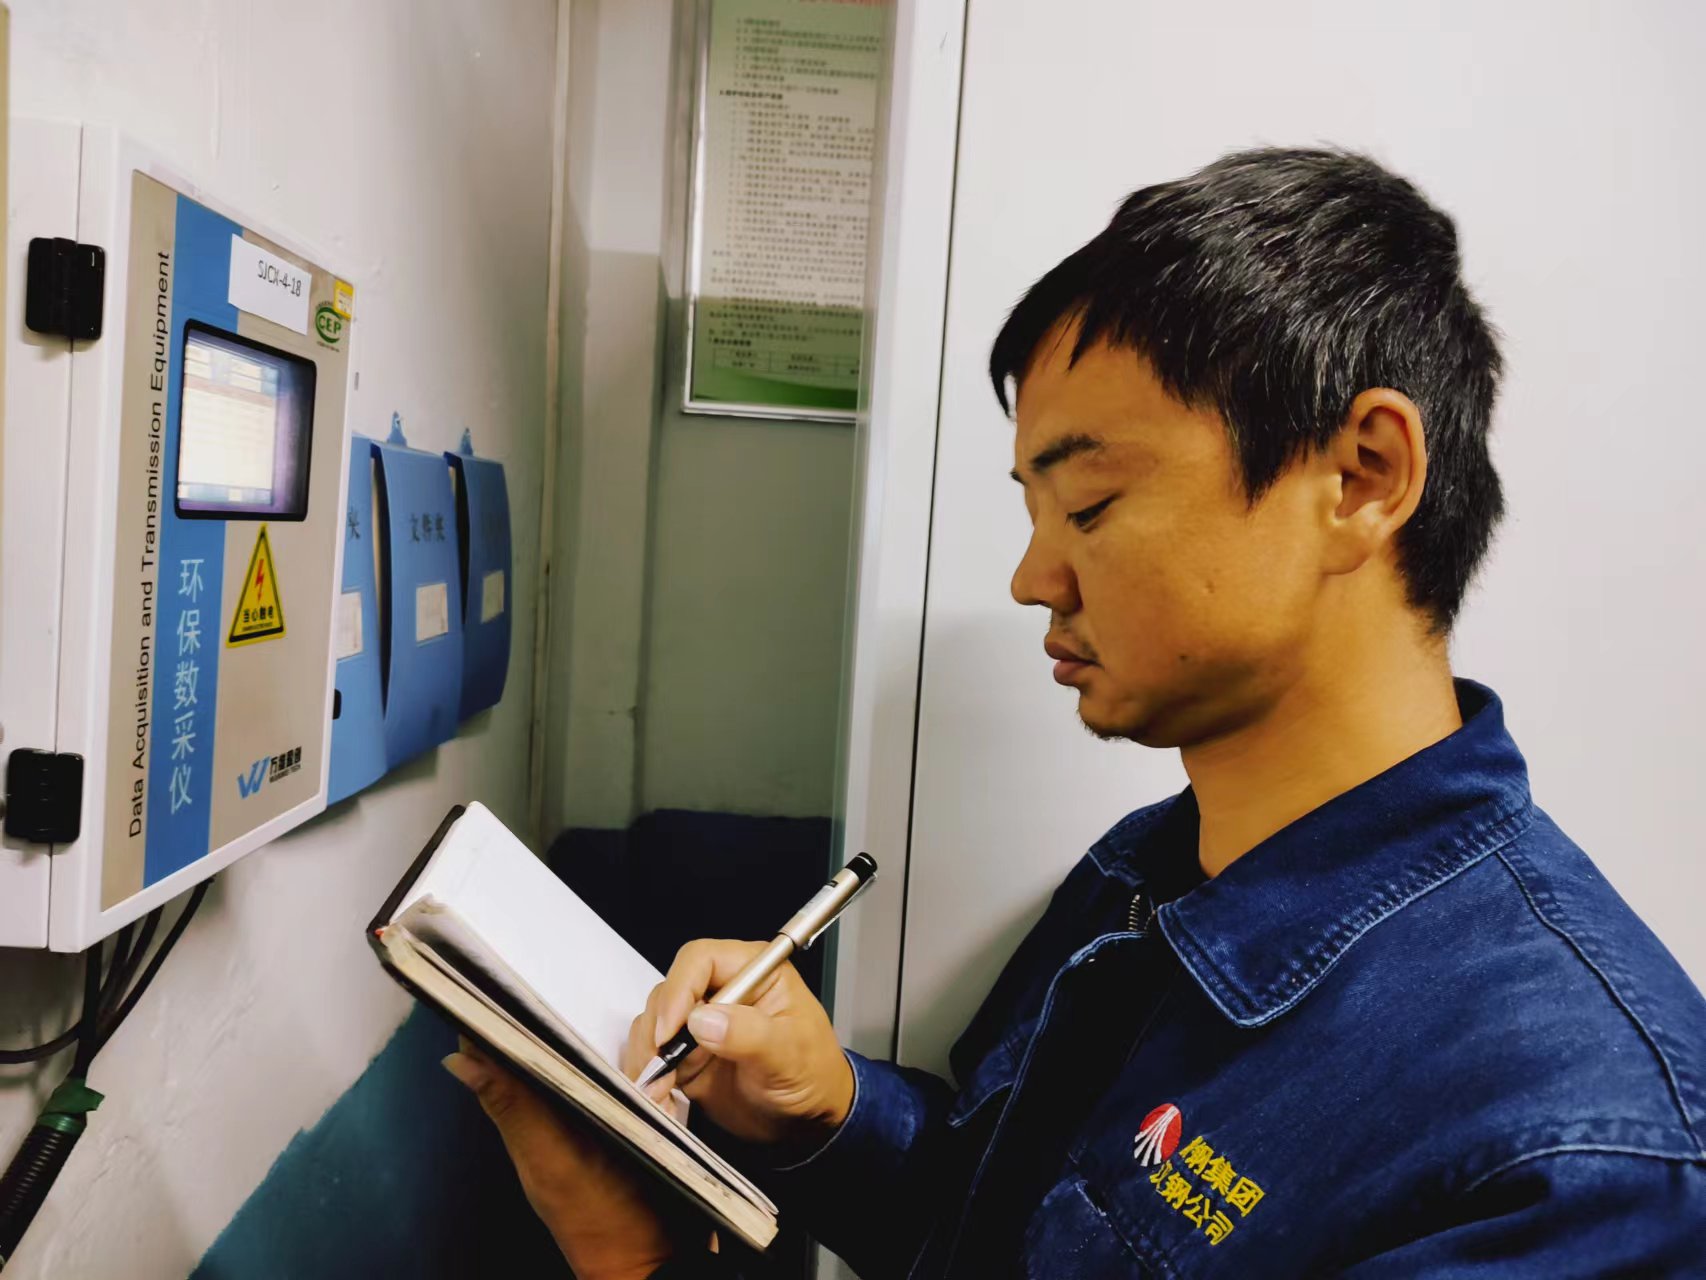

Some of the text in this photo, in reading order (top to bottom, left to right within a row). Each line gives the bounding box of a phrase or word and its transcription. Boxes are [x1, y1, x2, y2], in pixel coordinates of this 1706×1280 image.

[258, 260, 302, 297] SJCX-4-18
[319, 315, 342, 335] CEP
[129, 251, 170, 838] Data Acquisition and Transmission Equipment
[169, 558, 204, 815] 环保数采仪
[1179, 1135, 1266, 1218] 钢集团
